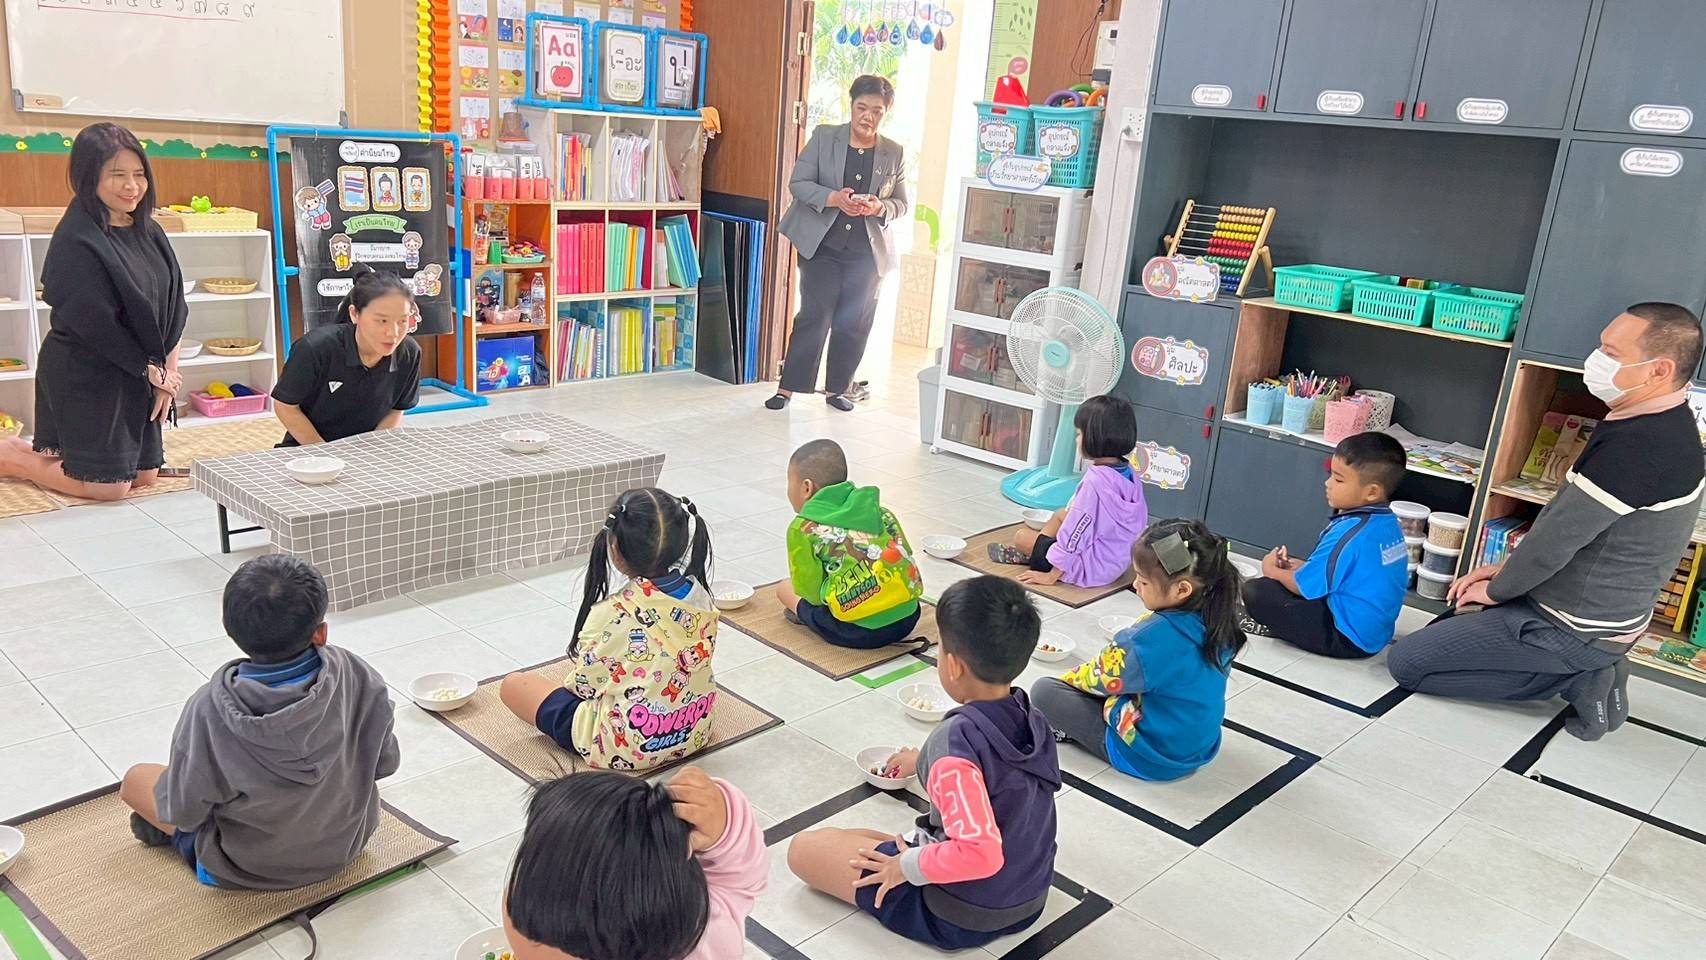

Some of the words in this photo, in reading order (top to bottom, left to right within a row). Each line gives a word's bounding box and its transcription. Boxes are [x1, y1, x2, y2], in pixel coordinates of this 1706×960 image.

[548, 34, 577, 58] Aa
[1168, 356, 1198, 374] ศิลปะ
[1150, 461, 1185, 478] วิทยาศาสตร์
[835, 559, 873, 595] BEN
[644, 728, 689, 751] GIRLS
